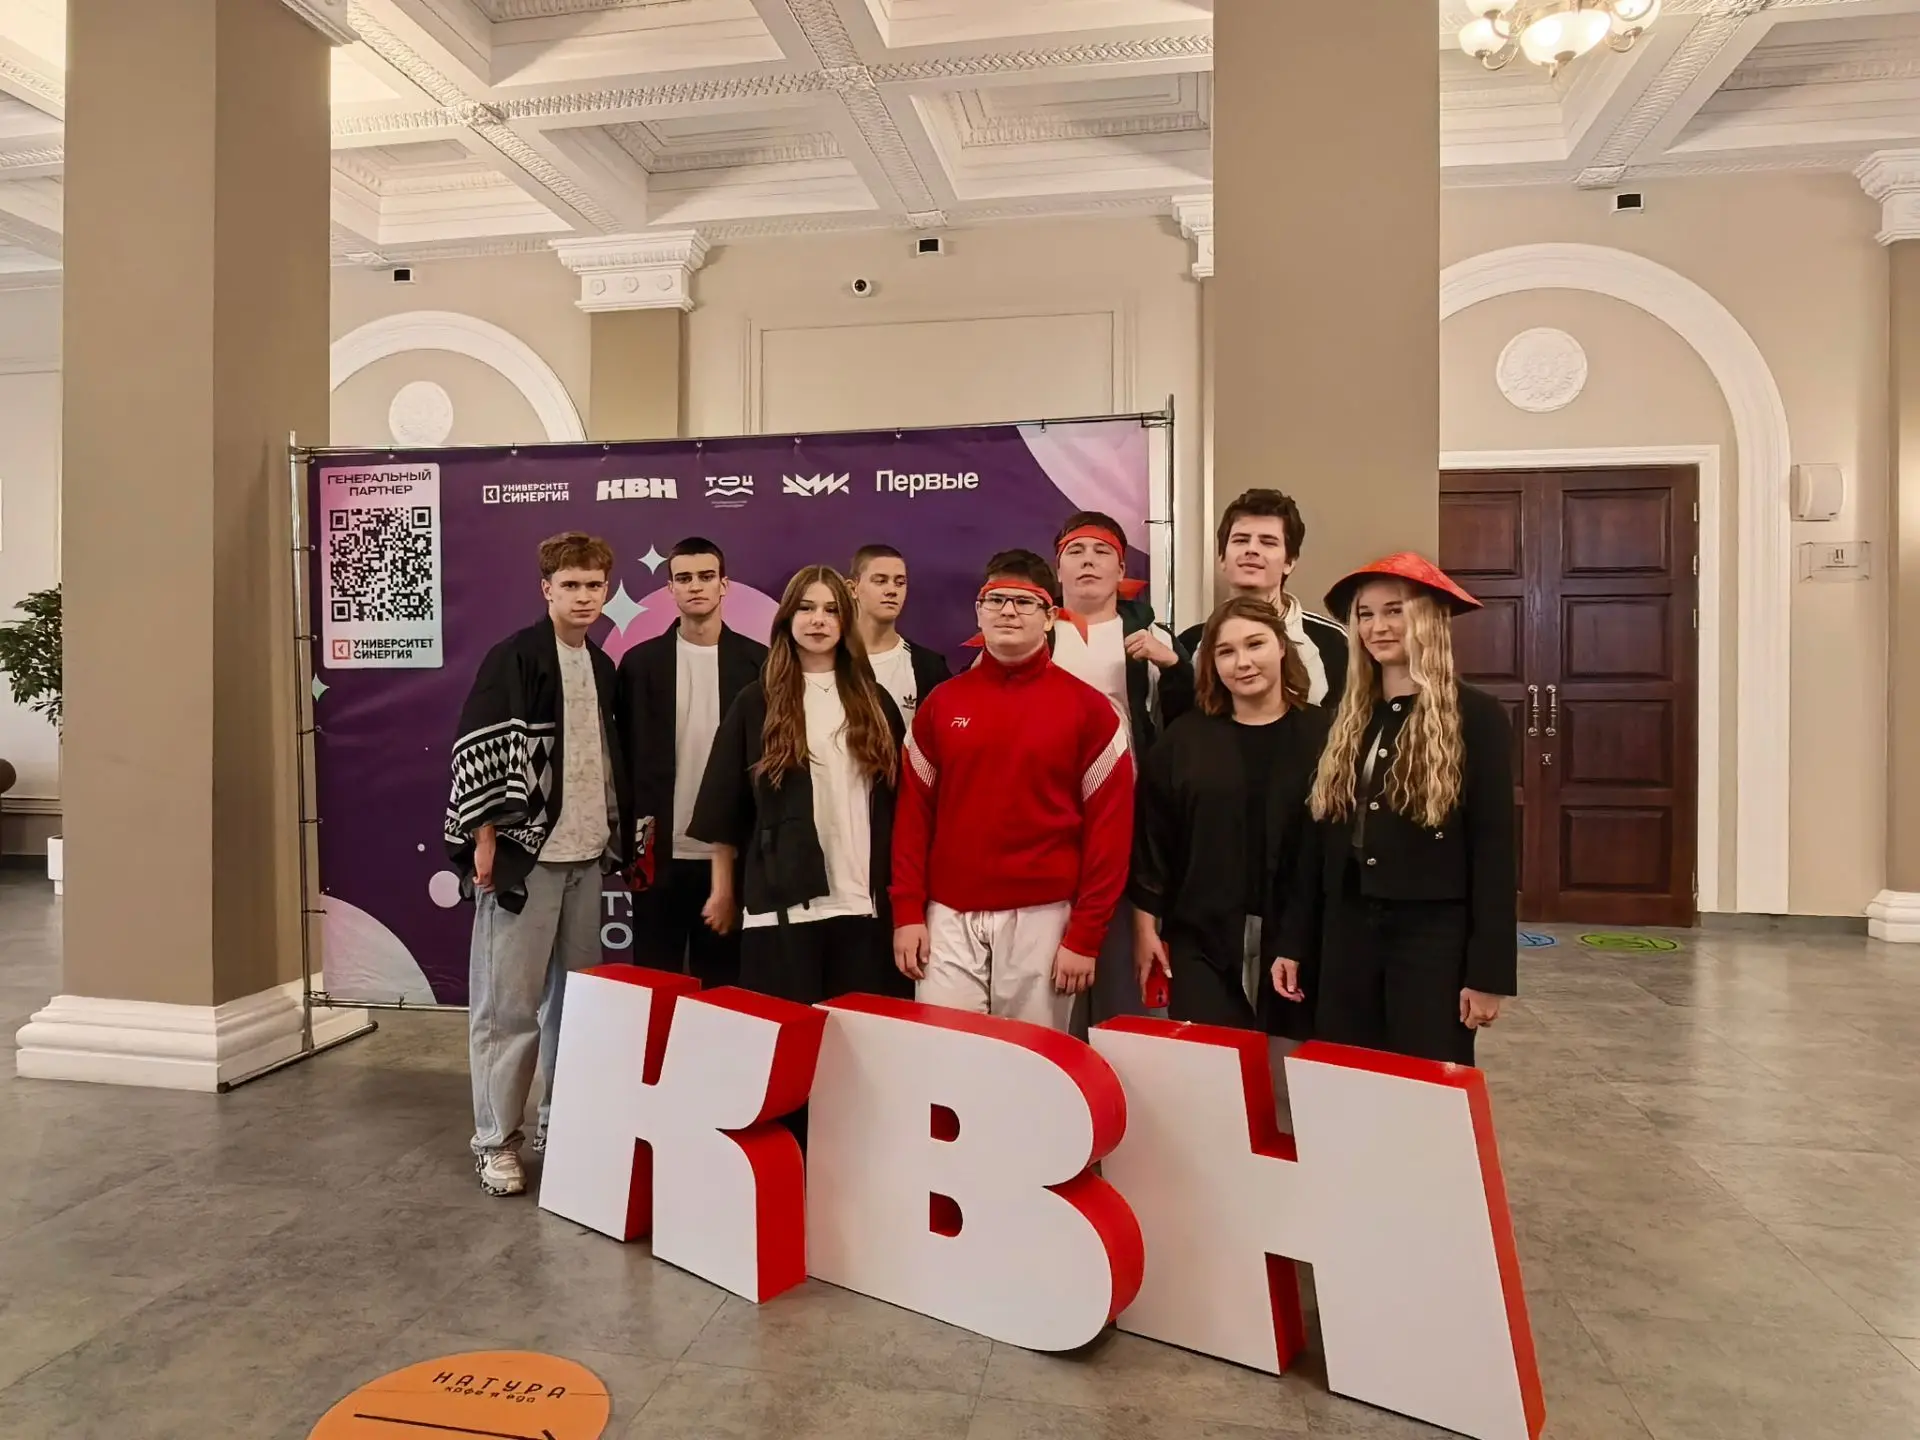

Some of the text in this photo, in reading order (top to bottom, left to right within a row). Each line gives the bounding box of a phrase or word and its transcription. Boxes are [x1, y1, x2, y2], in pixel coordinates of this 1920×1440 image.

[327, 469, 432, 485] ГЕНЕРАЛЬНЫЙ
[876, 469, 979, 498] Первые
[349, 485, 413, 496] ПАРТНЕР
[502, 482, 569, 493] УНИВЕРСИТЕТ
[596, 478, 678, 501] КВН
[502, 491, 569, 504] СИНЕРГИЯ
[353, 638, 434, 650] УНИВЕРСИТЕТ
[353, 649, 413, 660] СИНЕРГИЯ
[539, 964, 1546, 1440] КВН
[432, 1371, 566, 1399] НАТУРА
